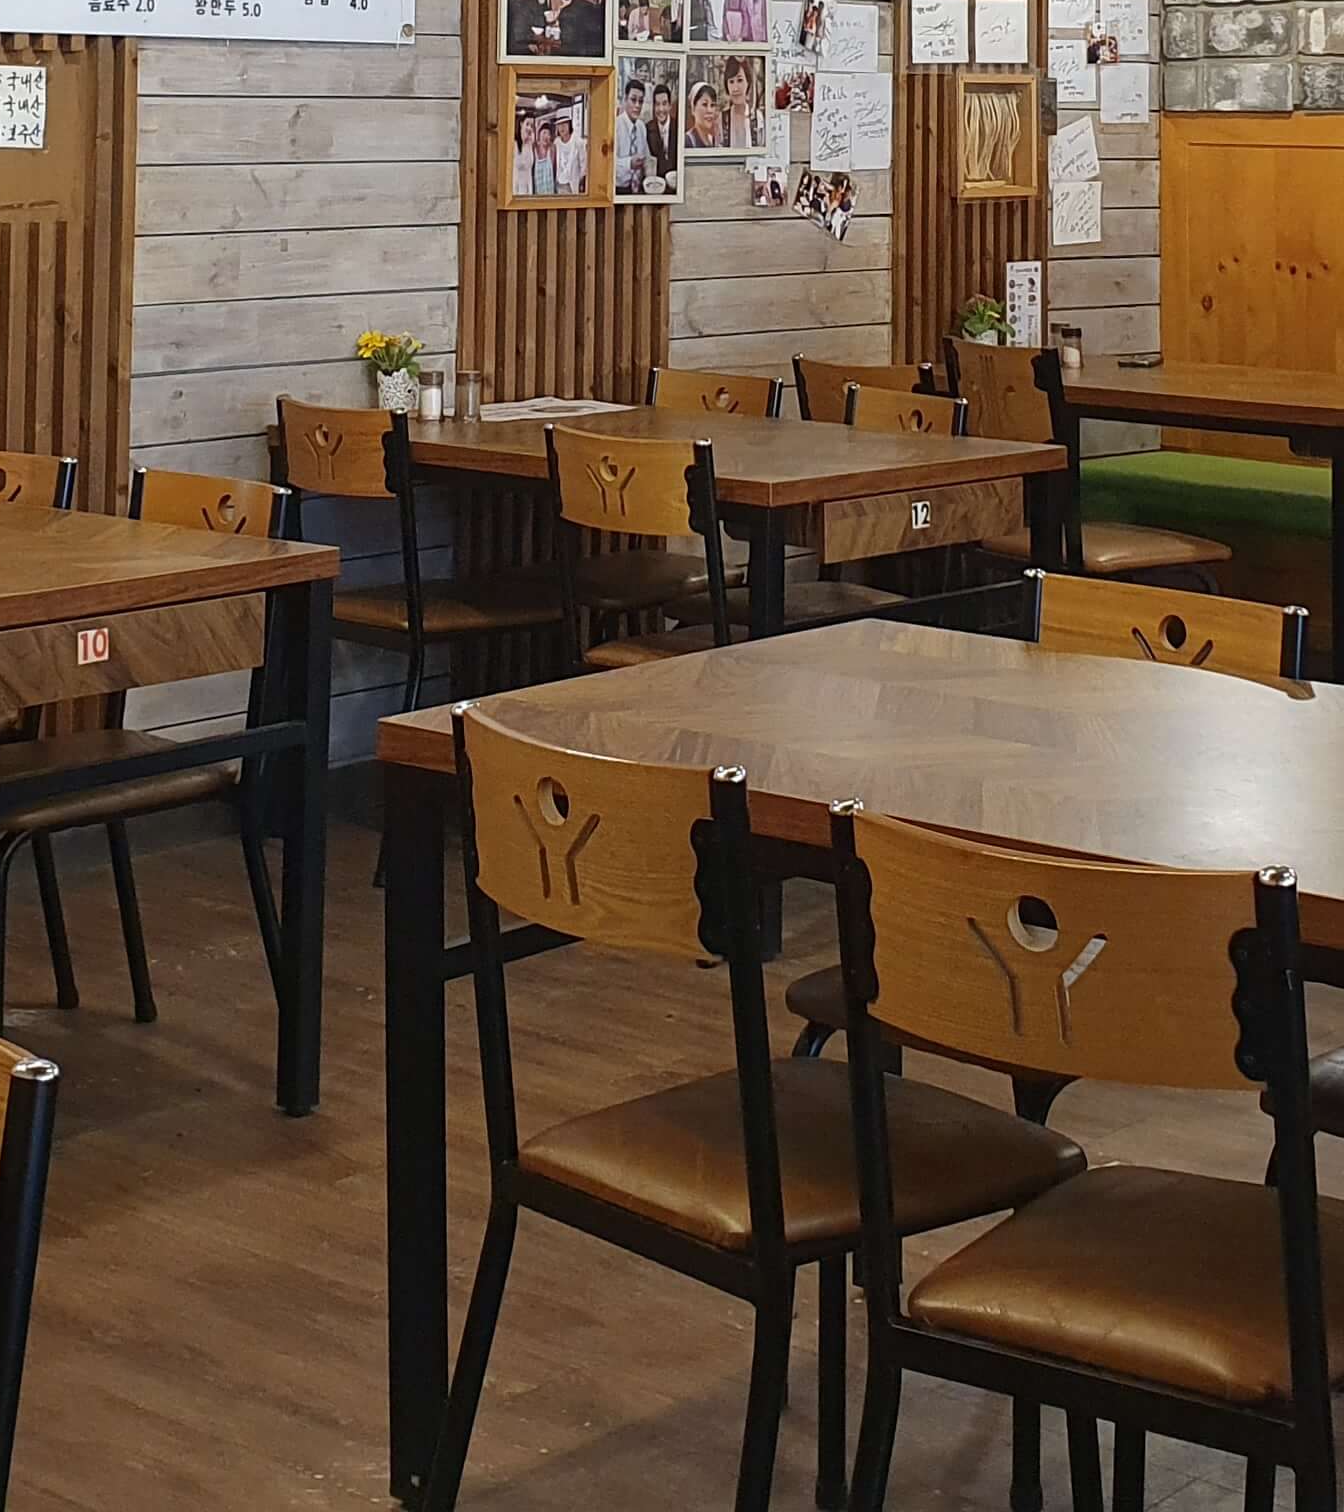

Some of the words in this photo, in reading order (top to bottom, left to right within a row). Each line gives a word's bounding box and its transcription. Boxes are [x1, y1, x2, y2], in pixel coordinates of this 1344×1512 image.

[242, 3, 262, 17] 5.0
[913, 503, 930, 526] 12
[80, 630, 108, 661] 10
